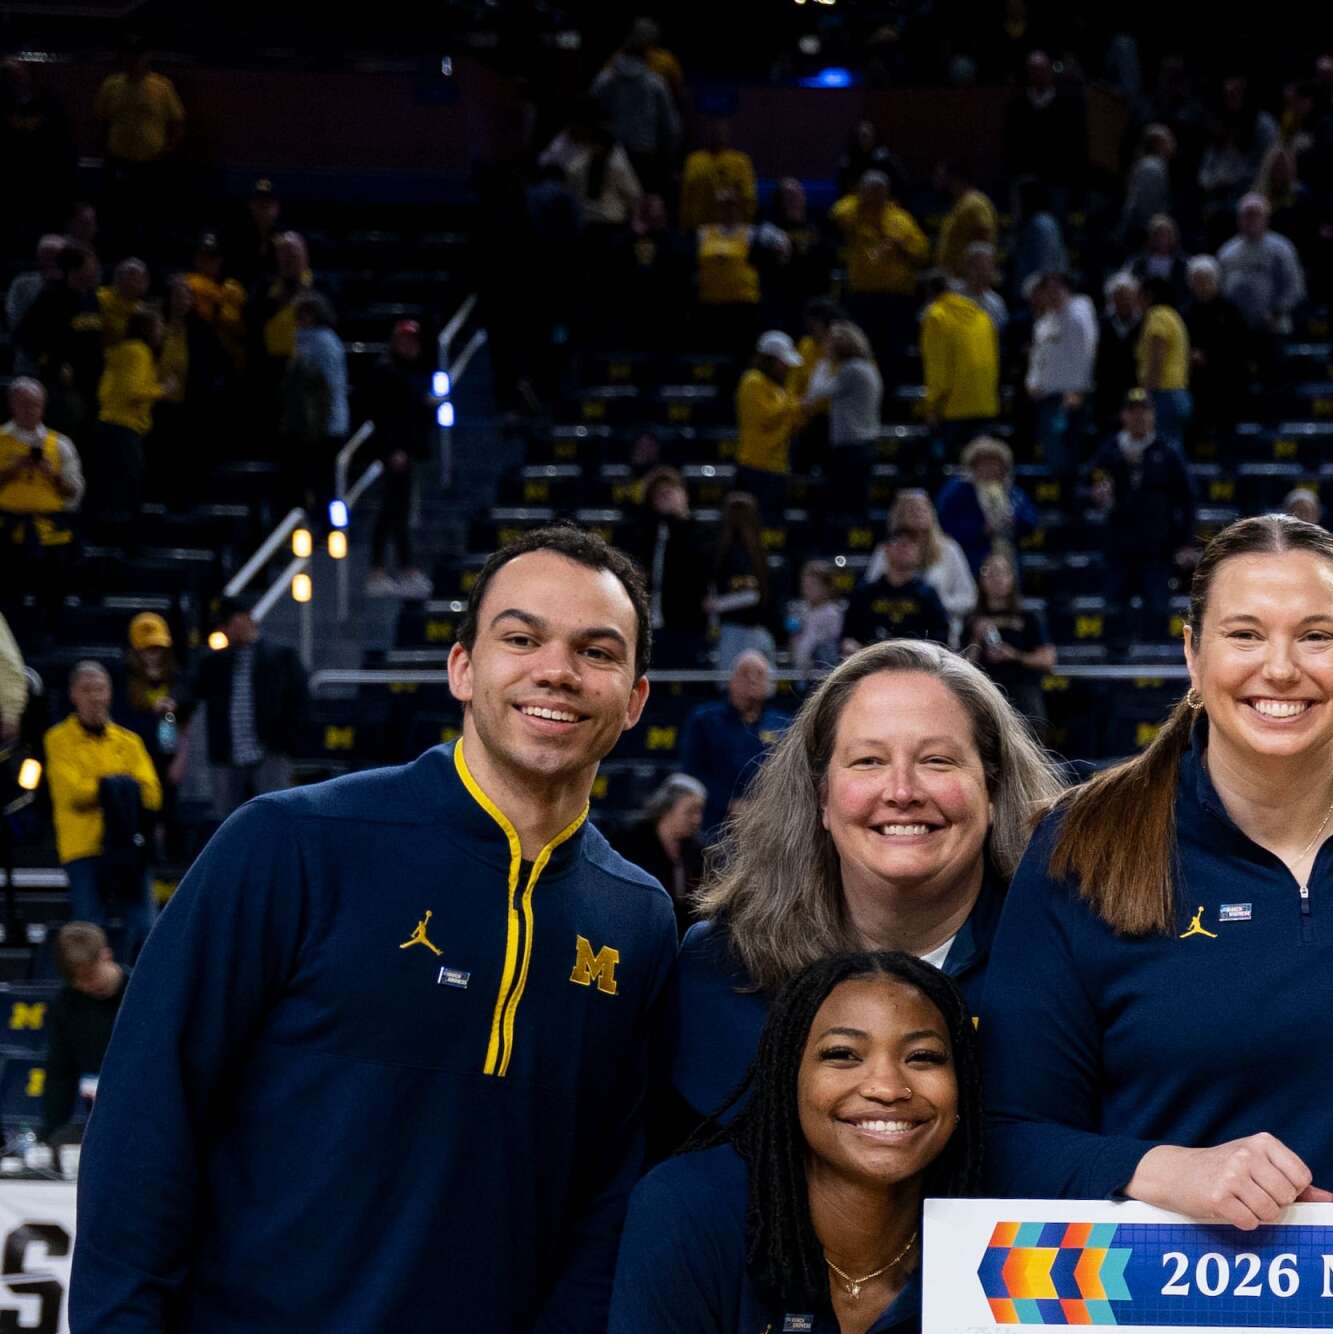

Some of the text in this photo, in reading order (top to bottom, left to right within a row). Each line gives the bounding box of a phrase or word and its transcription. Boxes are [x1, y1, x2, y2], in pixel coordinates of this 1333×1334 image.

[570, 934, 619, 995] M
[10, 1002, 46, 1029] M
[1161, 1251, 1299, 1298] 2026
